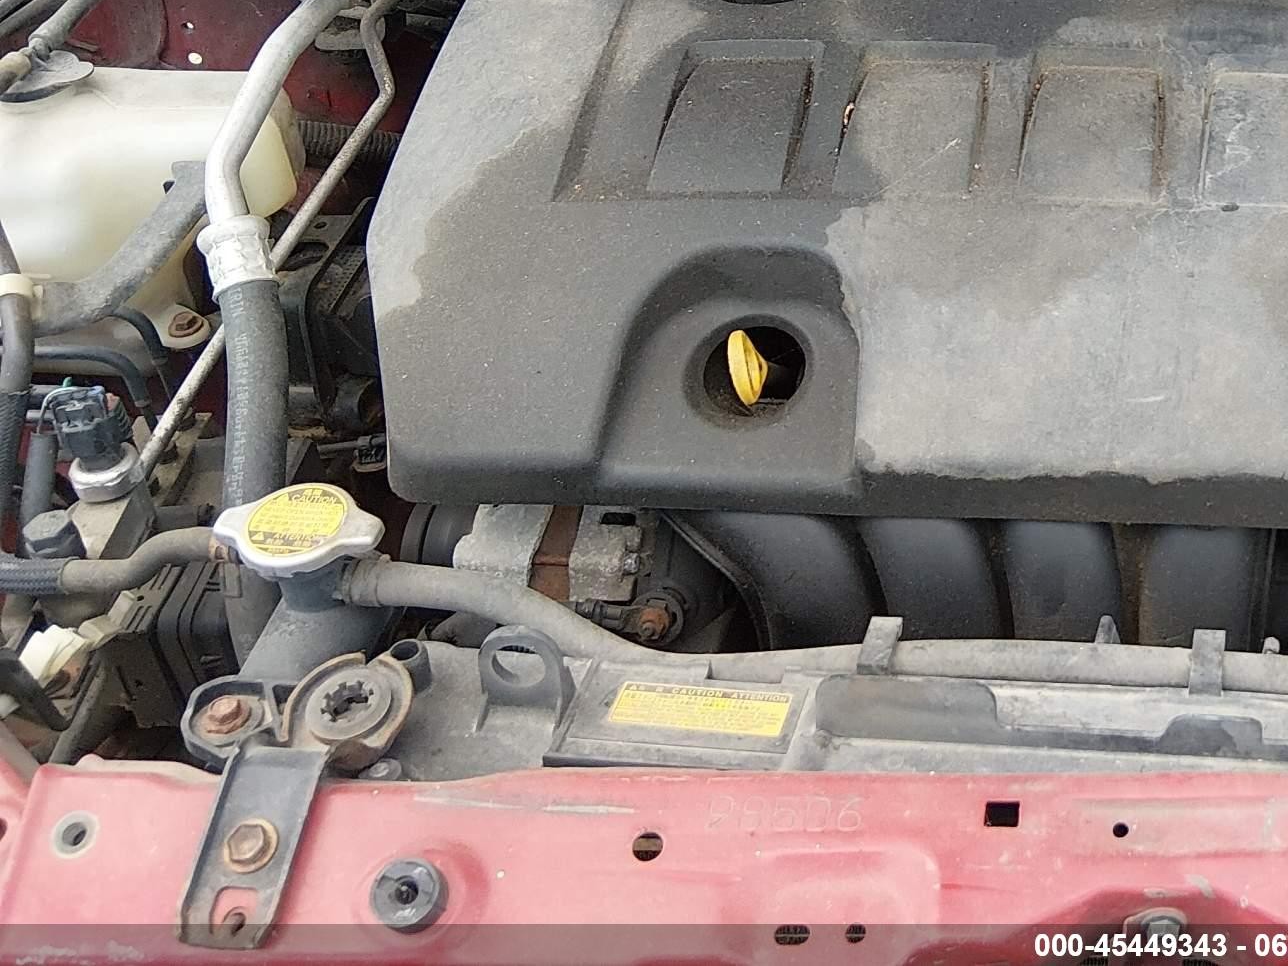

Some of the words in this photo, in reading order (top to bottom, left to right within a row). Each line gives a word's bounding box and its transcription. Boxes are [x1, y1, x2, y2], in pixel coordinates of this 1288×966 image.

[291, 494, 338, 505] CAUTION
[671, 687, 723, 698] CAUTION
[731, 692, 789, 703] ATTENTION
